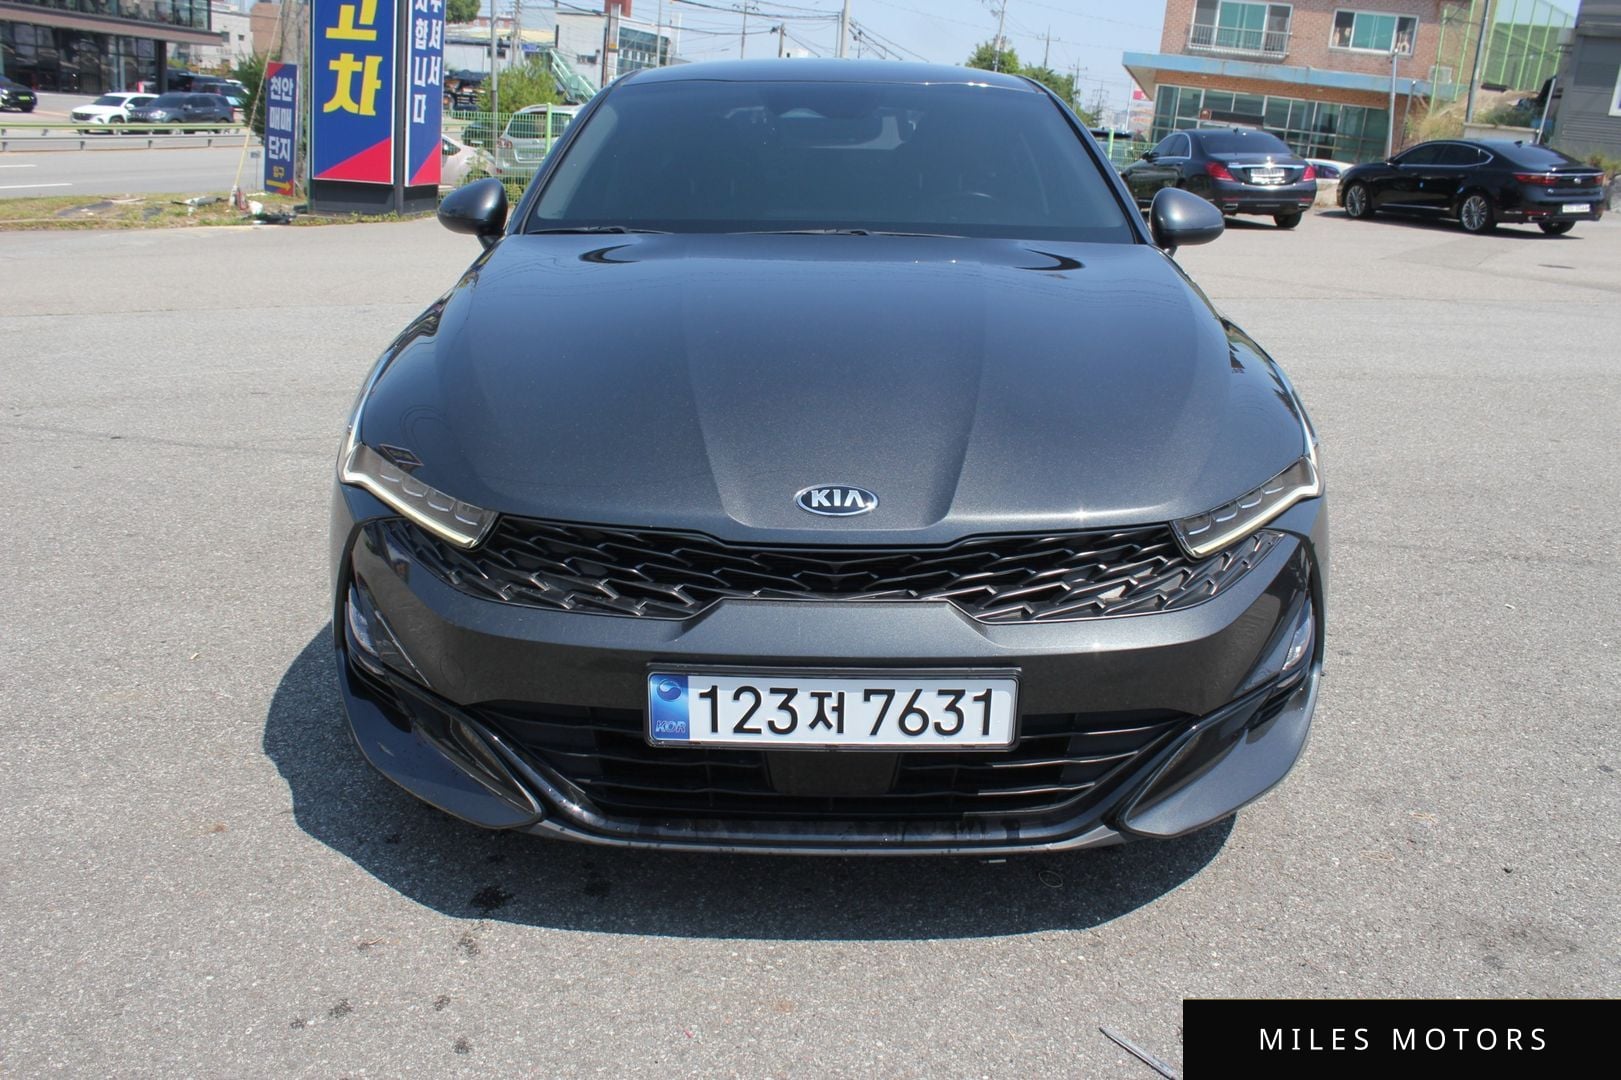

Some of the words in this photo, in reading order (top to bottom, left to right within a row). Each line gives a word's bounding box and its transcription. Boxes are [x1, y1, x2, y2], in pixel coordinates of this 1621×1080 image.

[270, 76, 294, 102] 천안
[269, 106, 292, 132] 매매
[268, 135, 291, 162] 단지
[811, 489, 866, 508] KIA
[699, 685, 845, 735] 123저
[863, 688, 993, 736] 7631
[655, 720, 686, 733] KOR
